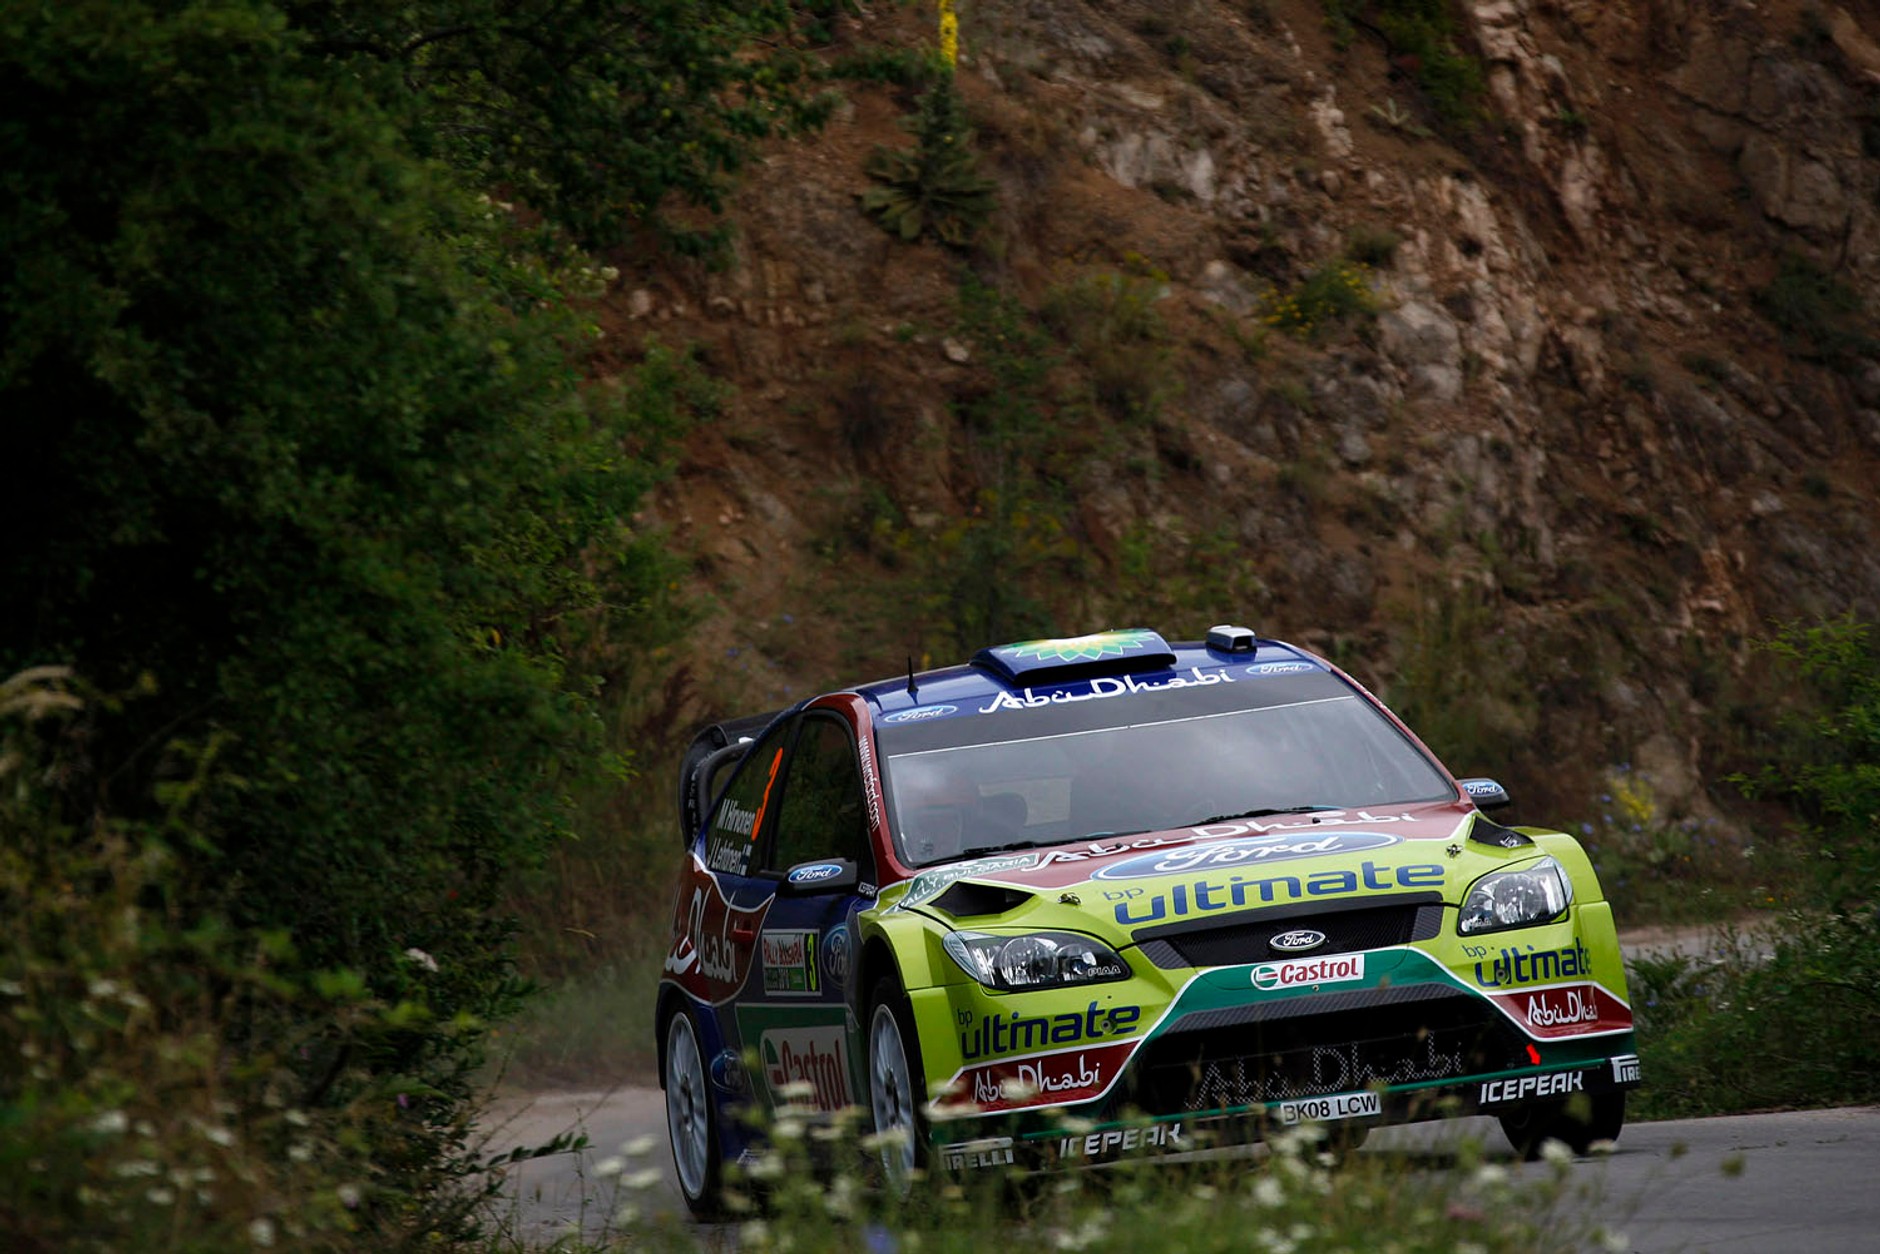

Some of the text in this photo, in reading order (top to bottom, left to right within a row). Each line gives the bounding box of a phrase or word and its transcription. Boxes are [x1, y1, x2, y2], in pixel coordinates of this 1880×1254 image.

[1260, 663, 1302, 674] Ford
[979, 667, 1237, 713] Abu Dhabi
[897, 706, 944, 722] Ford
[1466, 781, 1498, 795] Ford
[1021, 810, 1418, 871] Abu Dhabi
[1154, 834, 1344, 872] Ford
[796, 867, 833, 881] Ford
[1103, 886, 1145, 901] bp
[1114, 860, 1446, 925] ultimate
[1281, 930, 1315, 948] Ford
[1462, 944, 1487, 959] bp
[1279, 956, 1360, 985] Castrol
[957, 1008, 973, 1027] bp
[1526, 992, 1567, 1027] Abu
[961, 1001, 1141, 1060] ultimate
[1018, 1054, 1101, 1094] Dhabi
[1302, 1031, 1464, 1094] Dhabi
[1479, 1070, 1585, 1104] ICEPEAK
[1283, 1094, 1377, 1122] BK08 LCW
[1060, 1122, 1181, 1160] ICEPEAK
